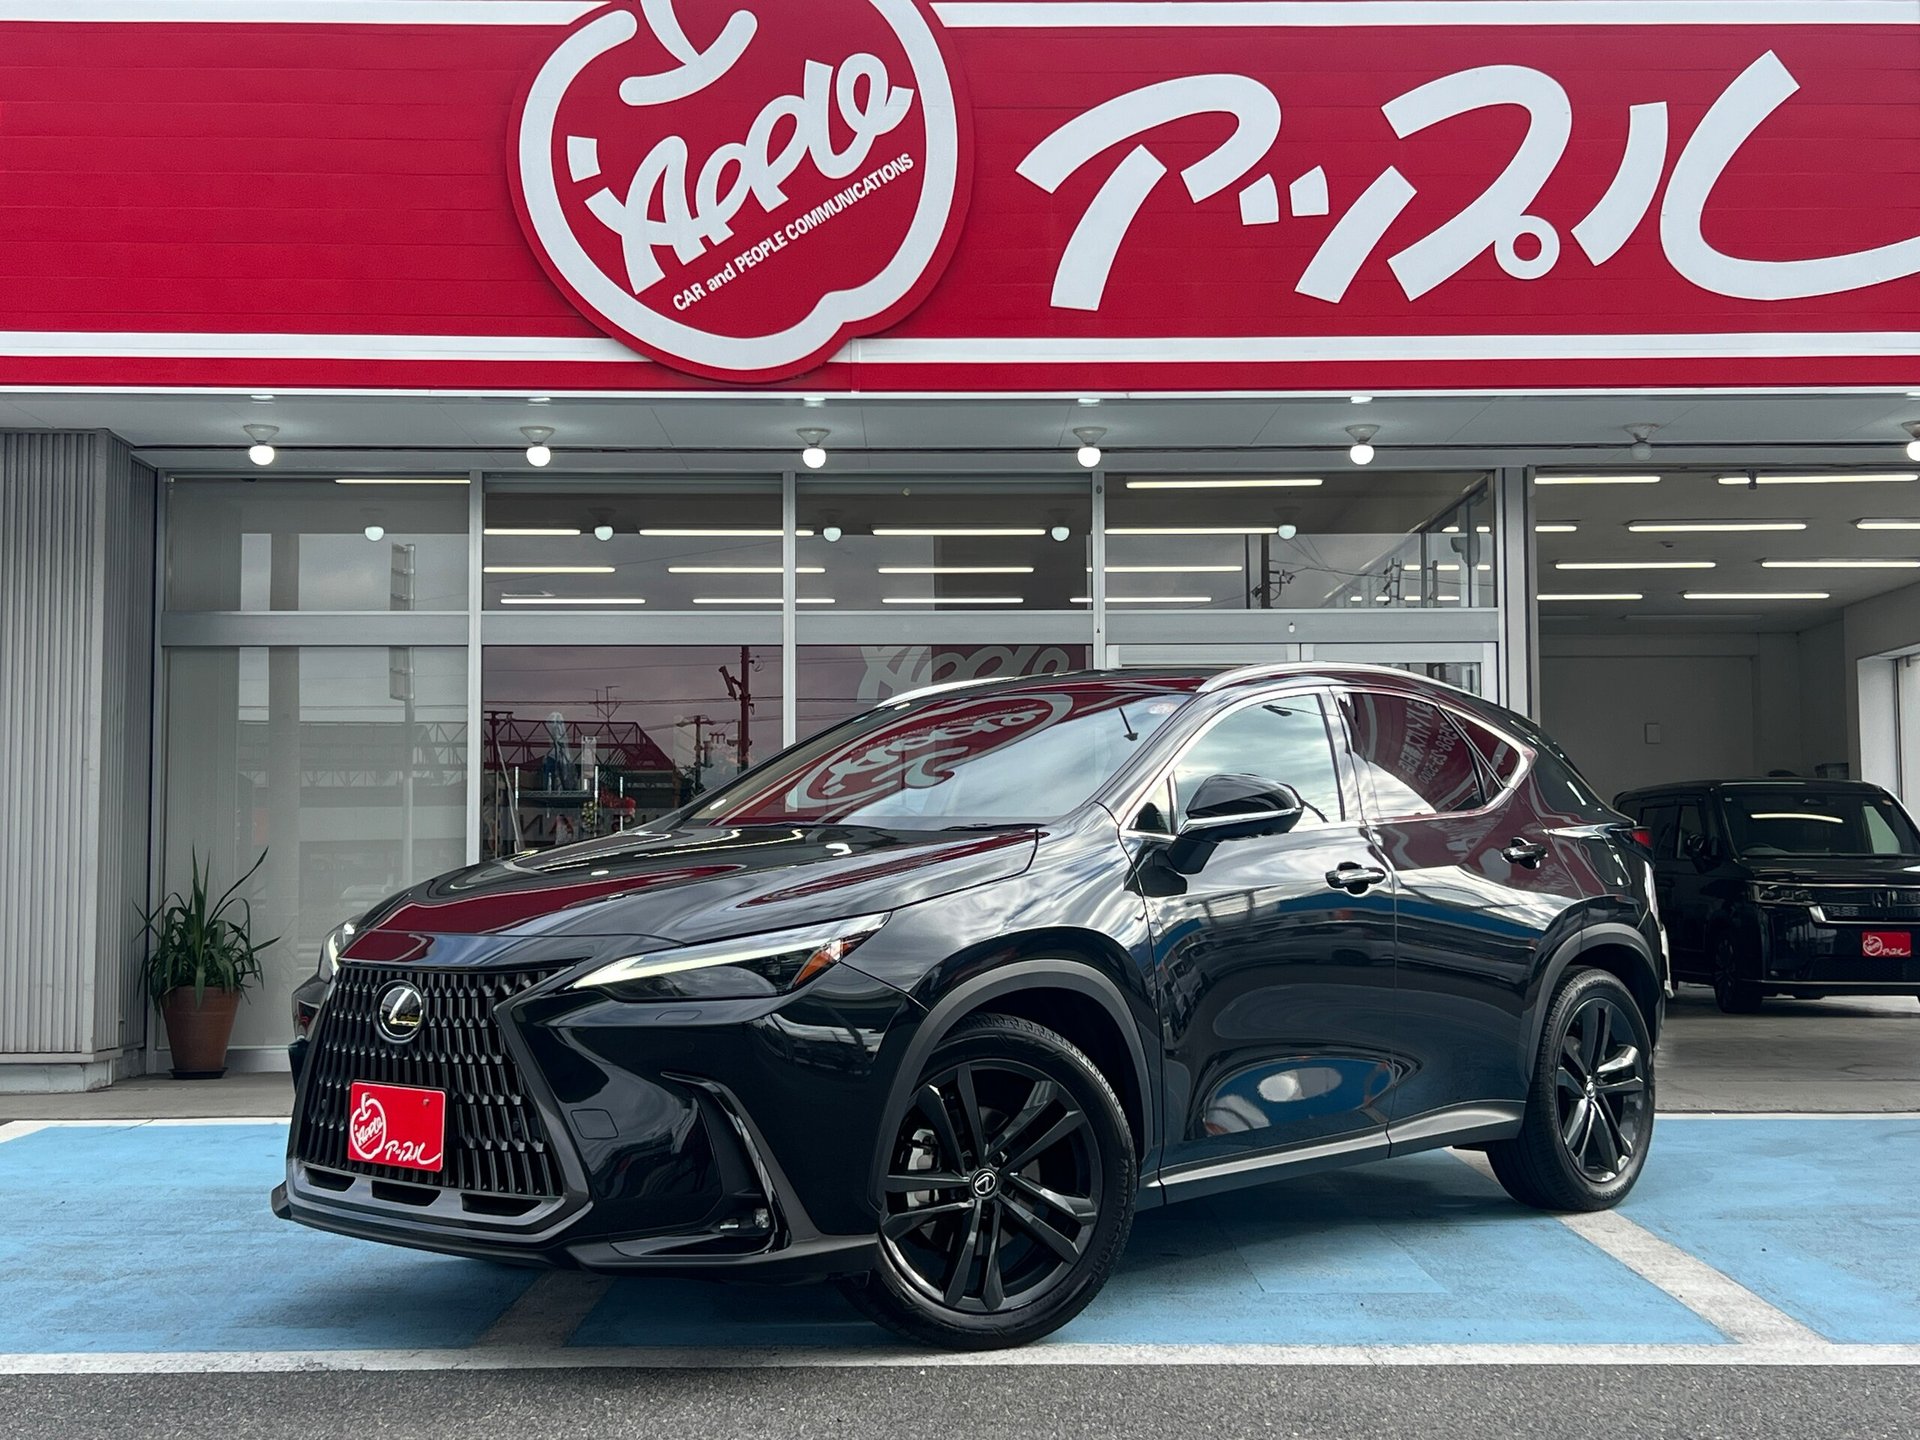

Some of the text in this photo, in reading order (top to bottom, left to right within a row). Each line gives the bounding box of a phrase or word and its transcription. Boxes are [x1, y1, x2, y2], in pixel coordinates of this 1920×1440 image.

[584, 53, 914, 294] Apple
[672, 152, 914, 311] CAR and PEOPLE COMMUNICATIONS
[1016, 49, 1920, 312] アップル
[384, 1139, 441, 1165] アップル
